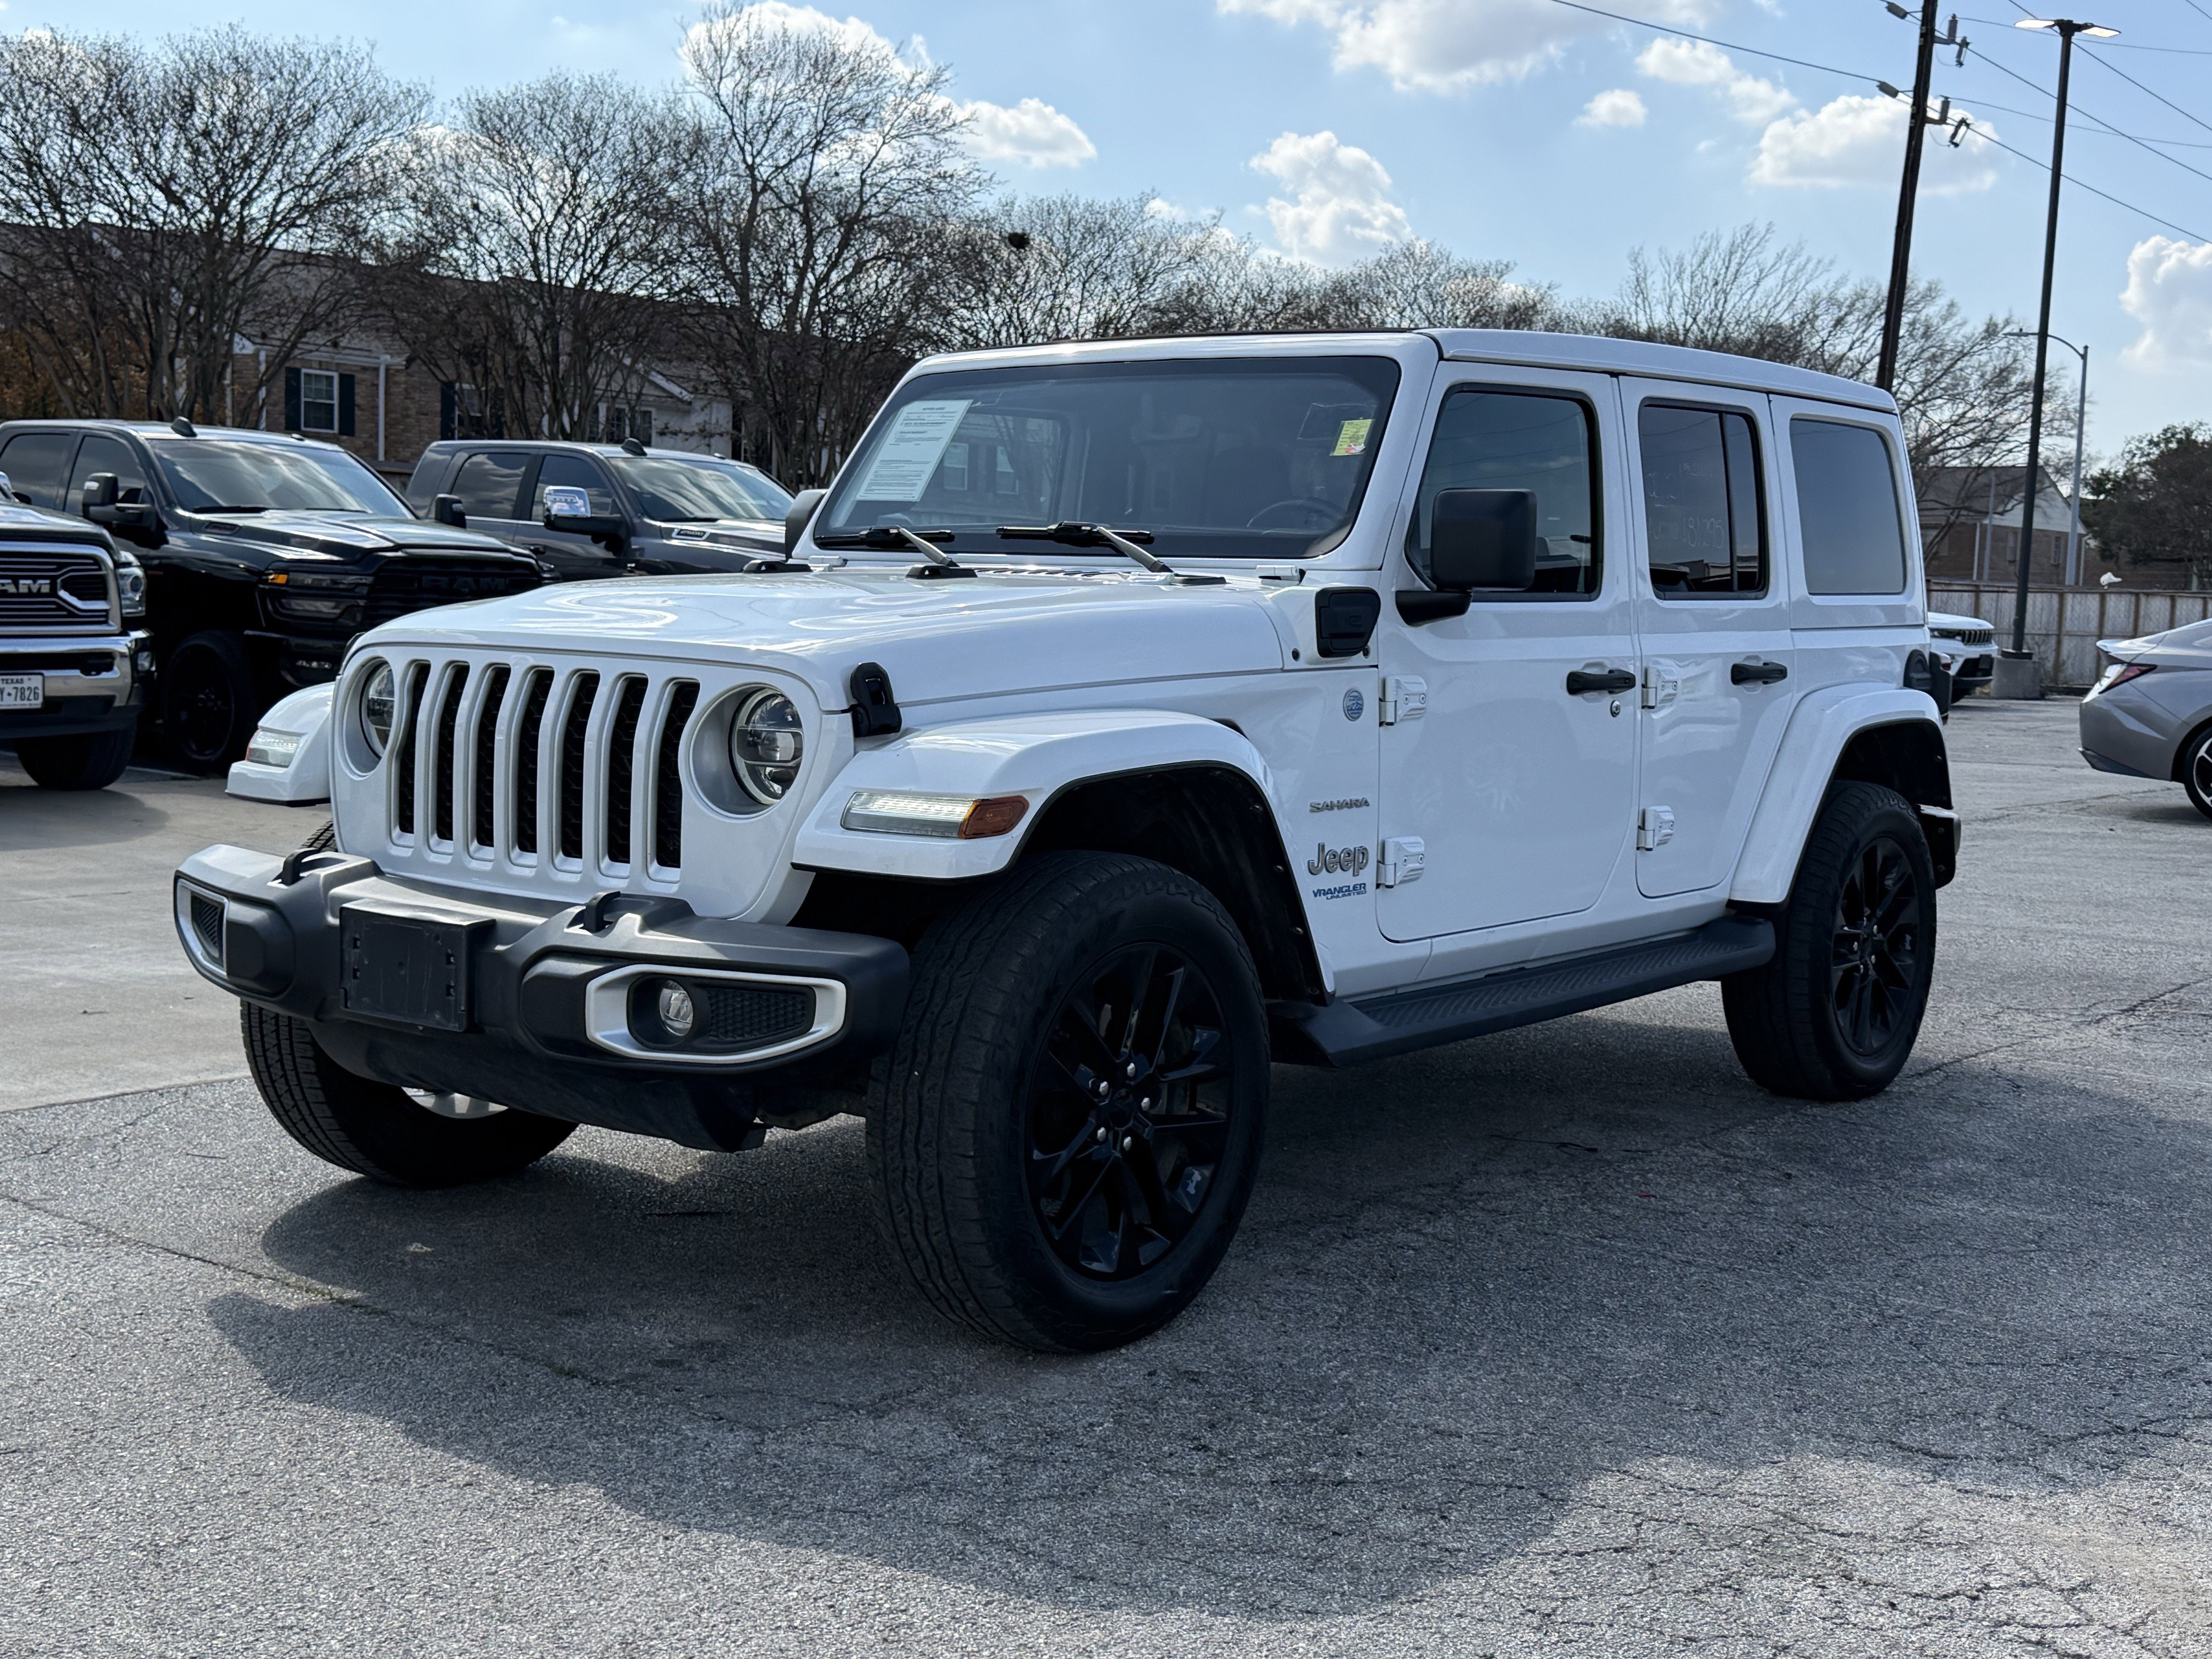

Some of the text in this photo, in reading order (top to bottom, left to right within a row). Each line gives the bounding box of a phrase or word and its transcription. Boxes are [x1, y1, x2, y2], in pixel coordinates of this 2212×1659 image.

[422, 576, 505, 589] RAM
[1310, 797, 1370, 812] SAHARA
[1308, 842, 1369, 876] Jeep
